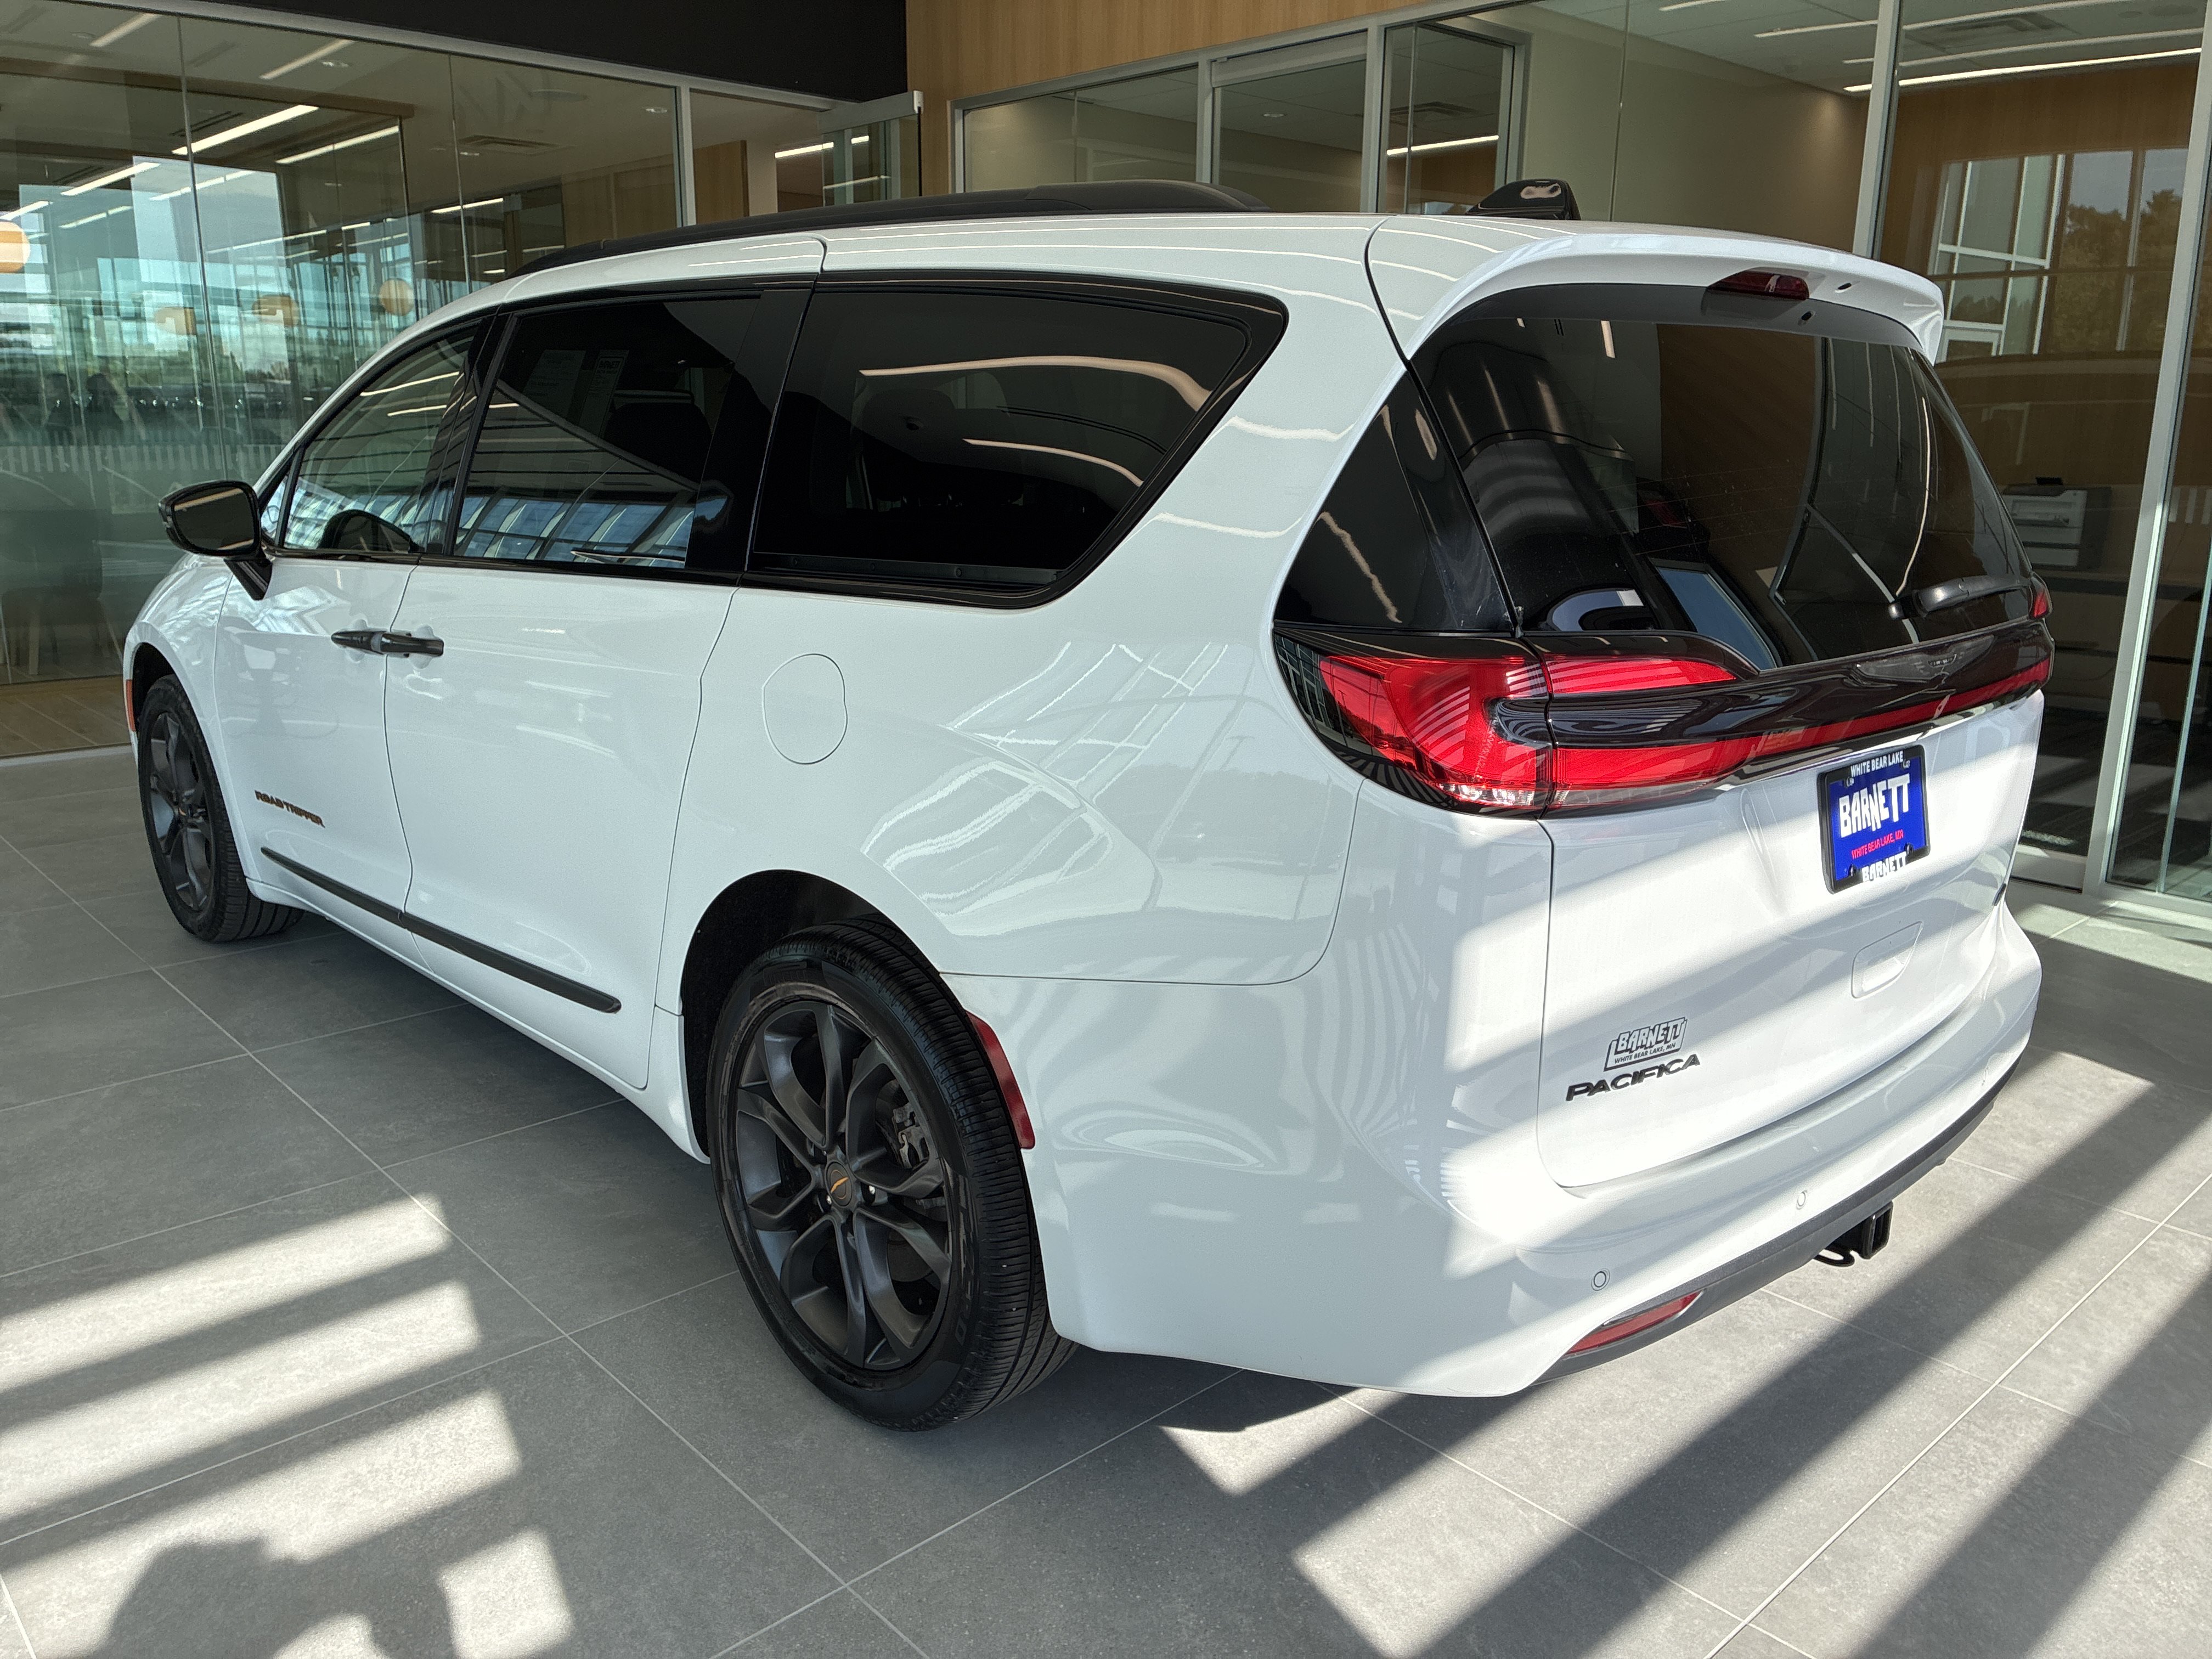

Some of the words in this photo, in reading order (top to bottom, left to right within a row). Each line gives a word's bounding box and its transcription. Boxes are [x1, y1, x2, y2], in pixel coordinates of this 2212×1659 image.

[1850, 760, 1870, 777] WHITE
[1871, 755, 1887, 771] BEAR
[1888, 751, 1904, 766] LAKE
[1839, 773, 1910, 838] BARNETT
[1852, 844, 1868, 860] WHITE
[1867, 838, 1881, 853] BEAR
[1880, 832, 1895, 847] LAKE,
[1861, 851, 1907, 882] BARNETT
[1615, 1017, 1685, 1054] BARNETT
[1615, 1054, 1633, 1064] WHITE
[1634, 1051, 1648, 1059] BEAR
[1649, 1046, 1664, 1055] LAKE,
[1565, 1053, 1701, 1101] PACIFICA
